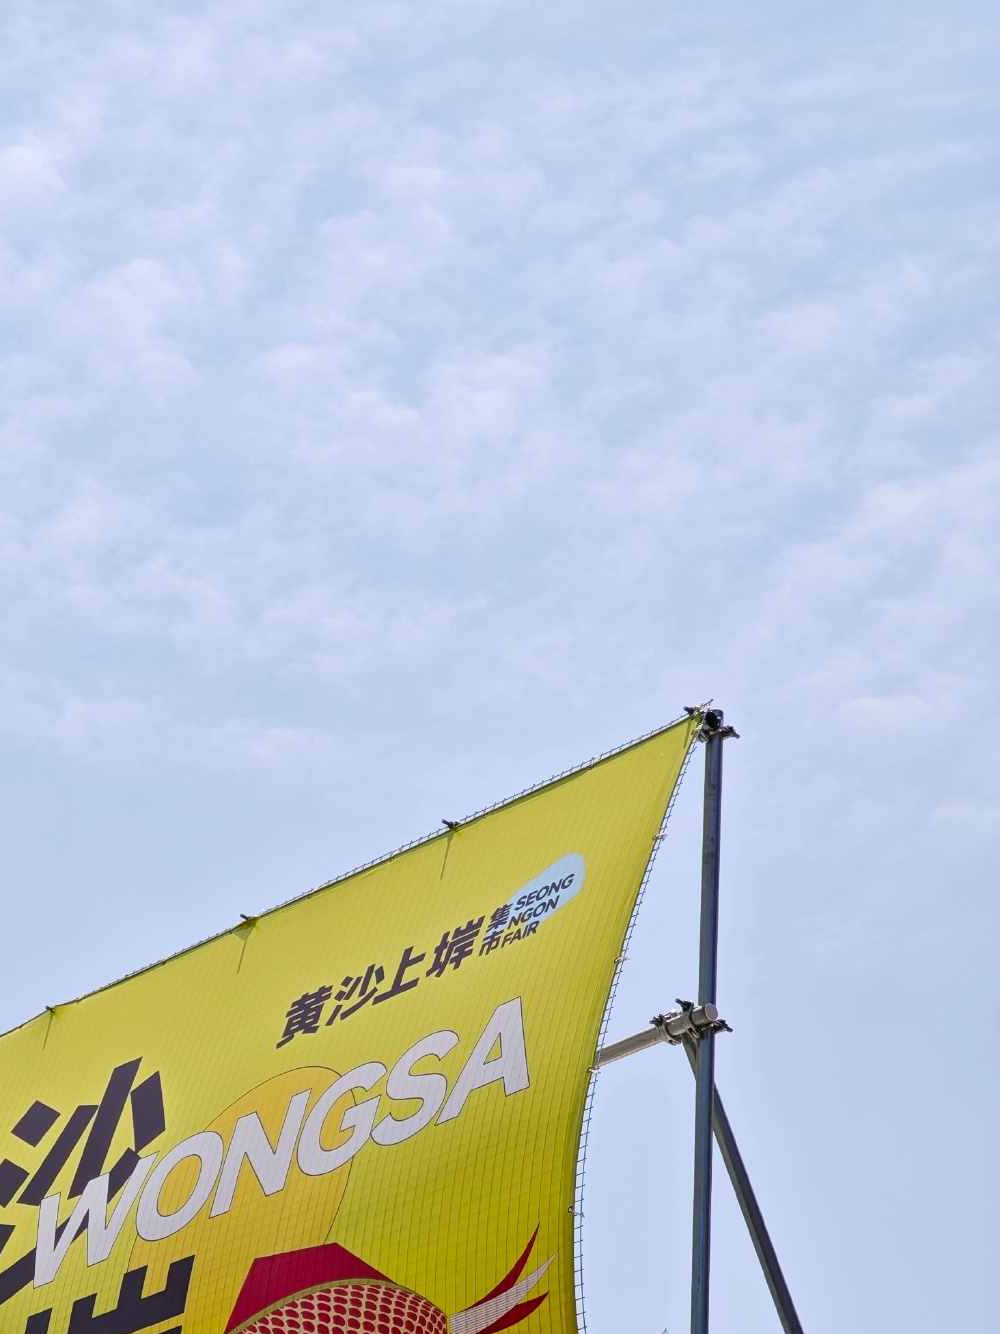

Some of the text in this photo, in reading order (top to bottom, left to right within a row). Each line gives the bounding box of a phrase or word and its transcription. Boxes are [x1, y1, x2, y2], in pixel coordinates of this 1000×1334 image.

[514, 873, 575, 911] SEONG
[506, 895, 560, 930] NGON
[500, 920, 540, 949] FAIR
[33, 995, 530, 1289] WONGSA
